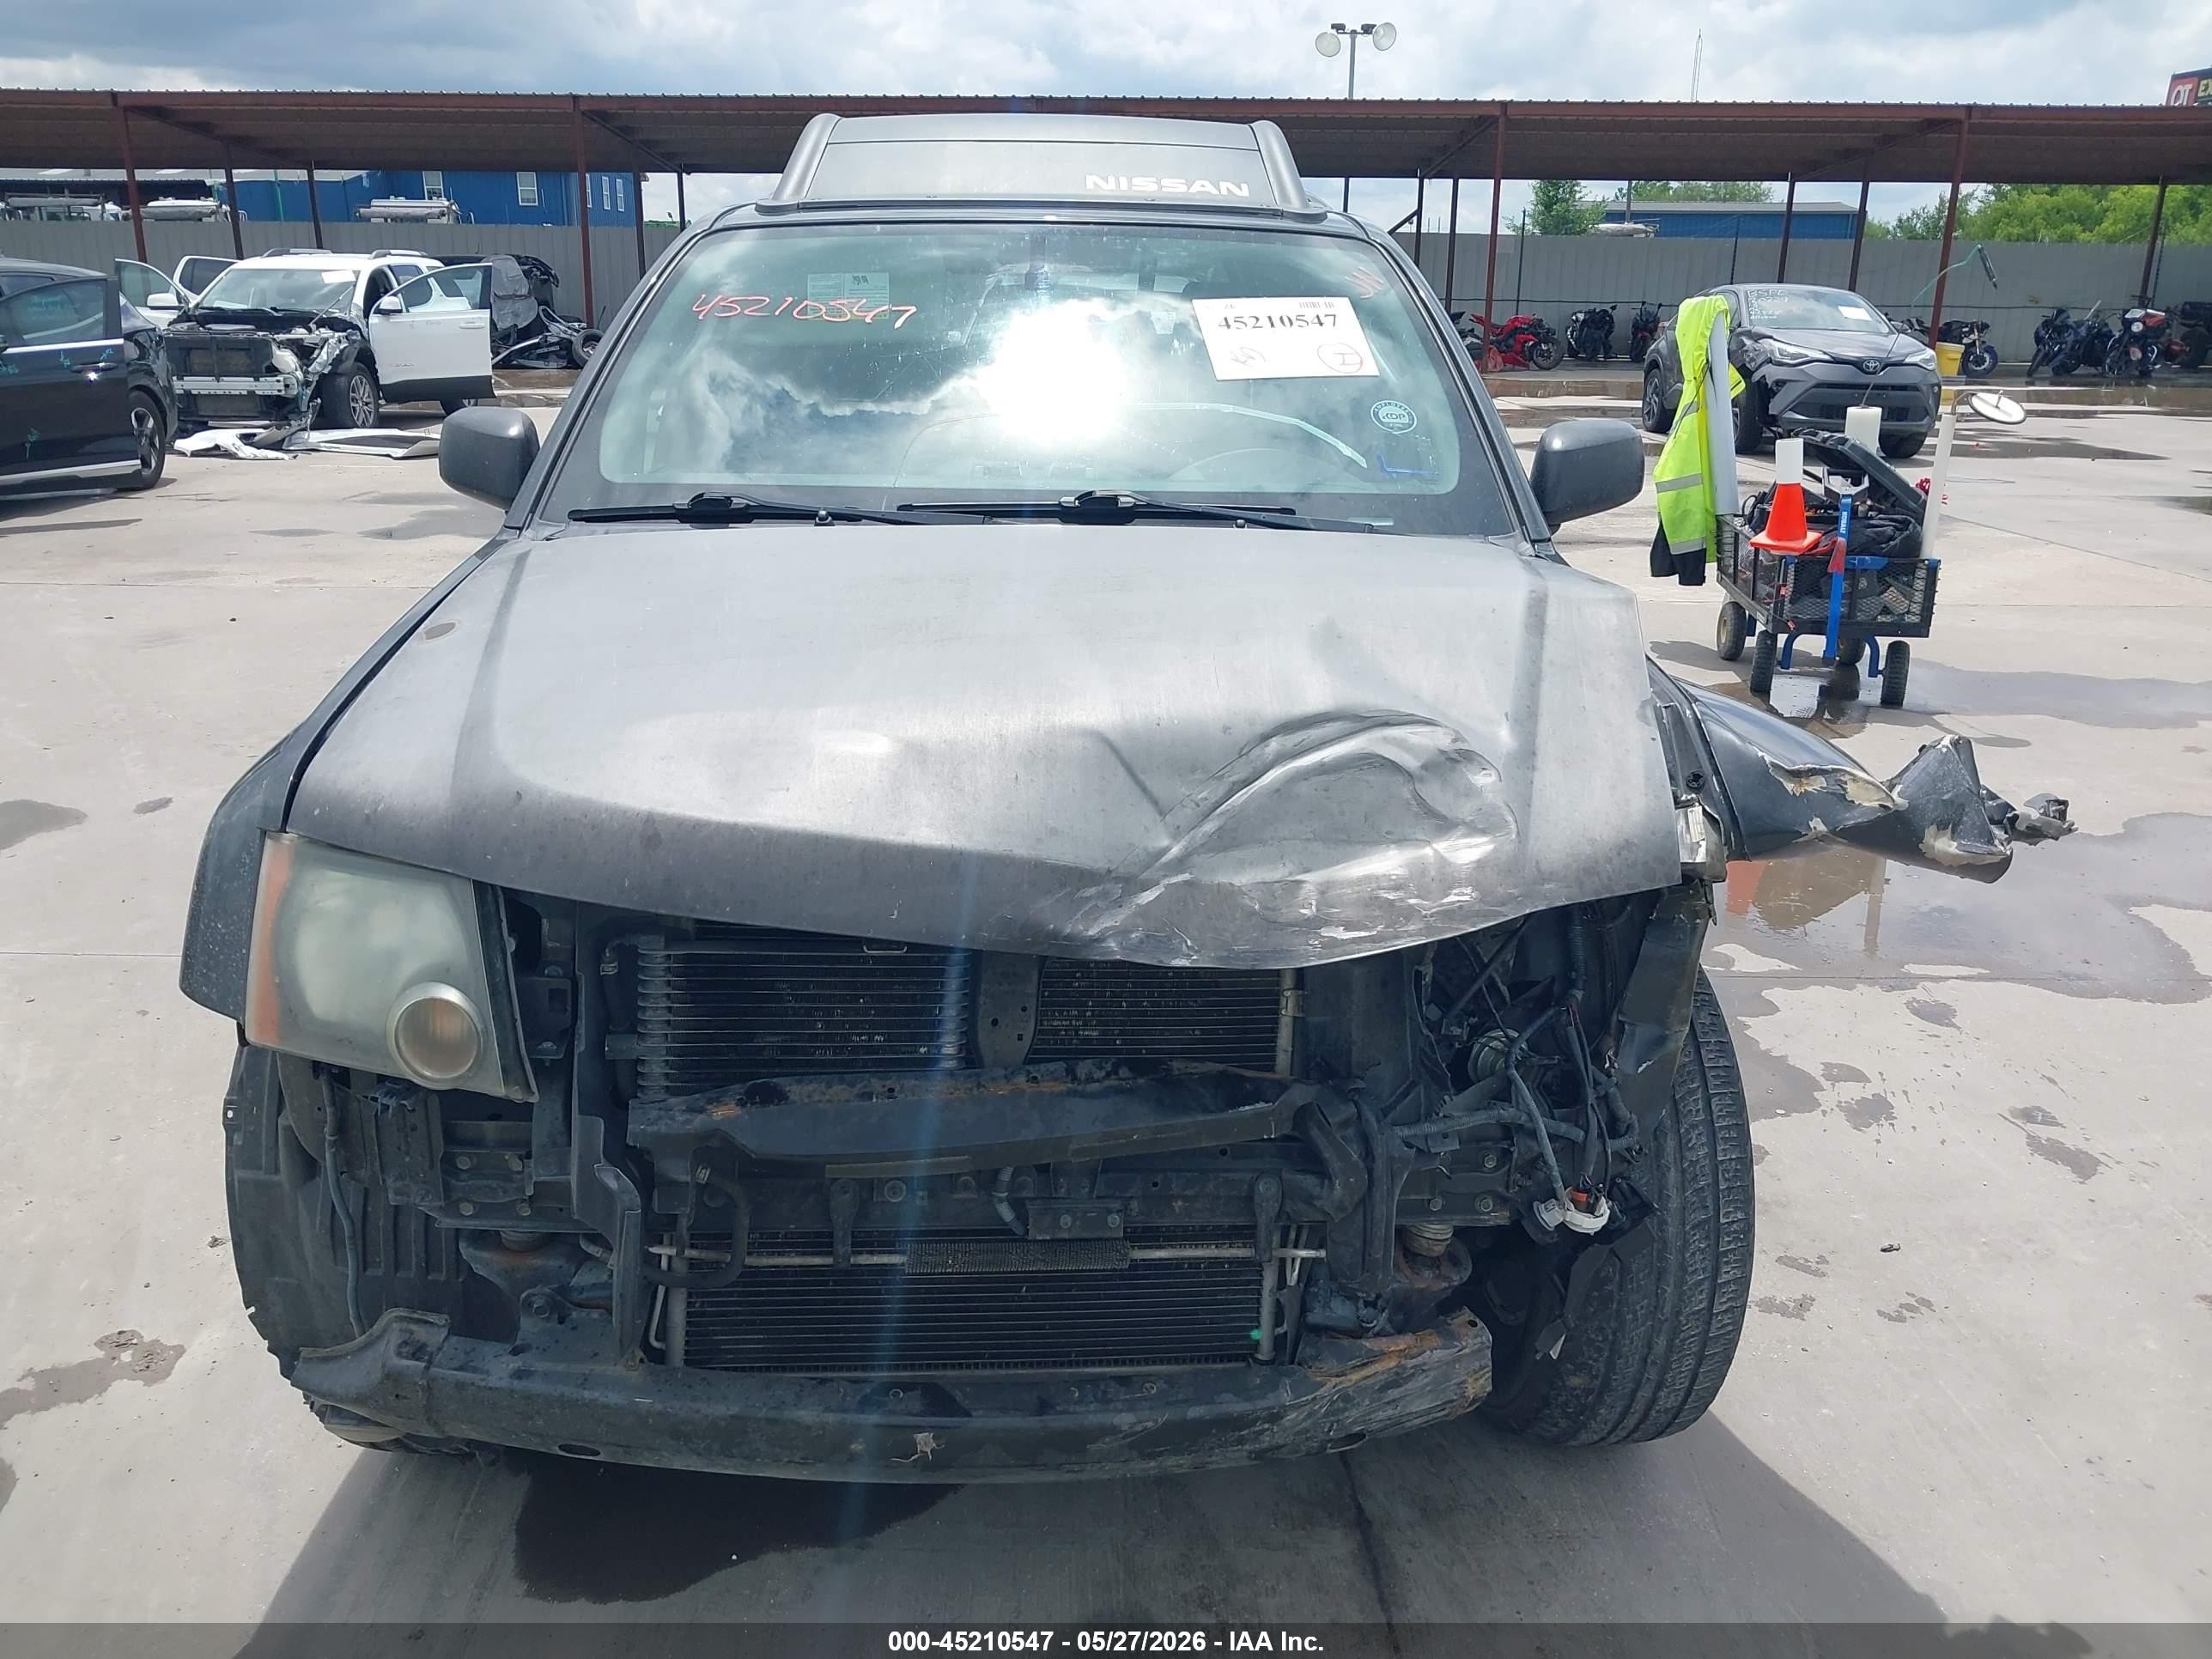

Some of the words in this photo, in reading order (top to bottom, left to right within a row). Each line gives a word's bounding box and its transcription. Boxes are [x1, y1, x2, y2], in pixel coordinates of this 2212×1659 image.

[1085, 174, 1249, 198] NISSAN
[691, 294, 917, 330] 45210547
[1217, 313, 1337, 331] 45210547
